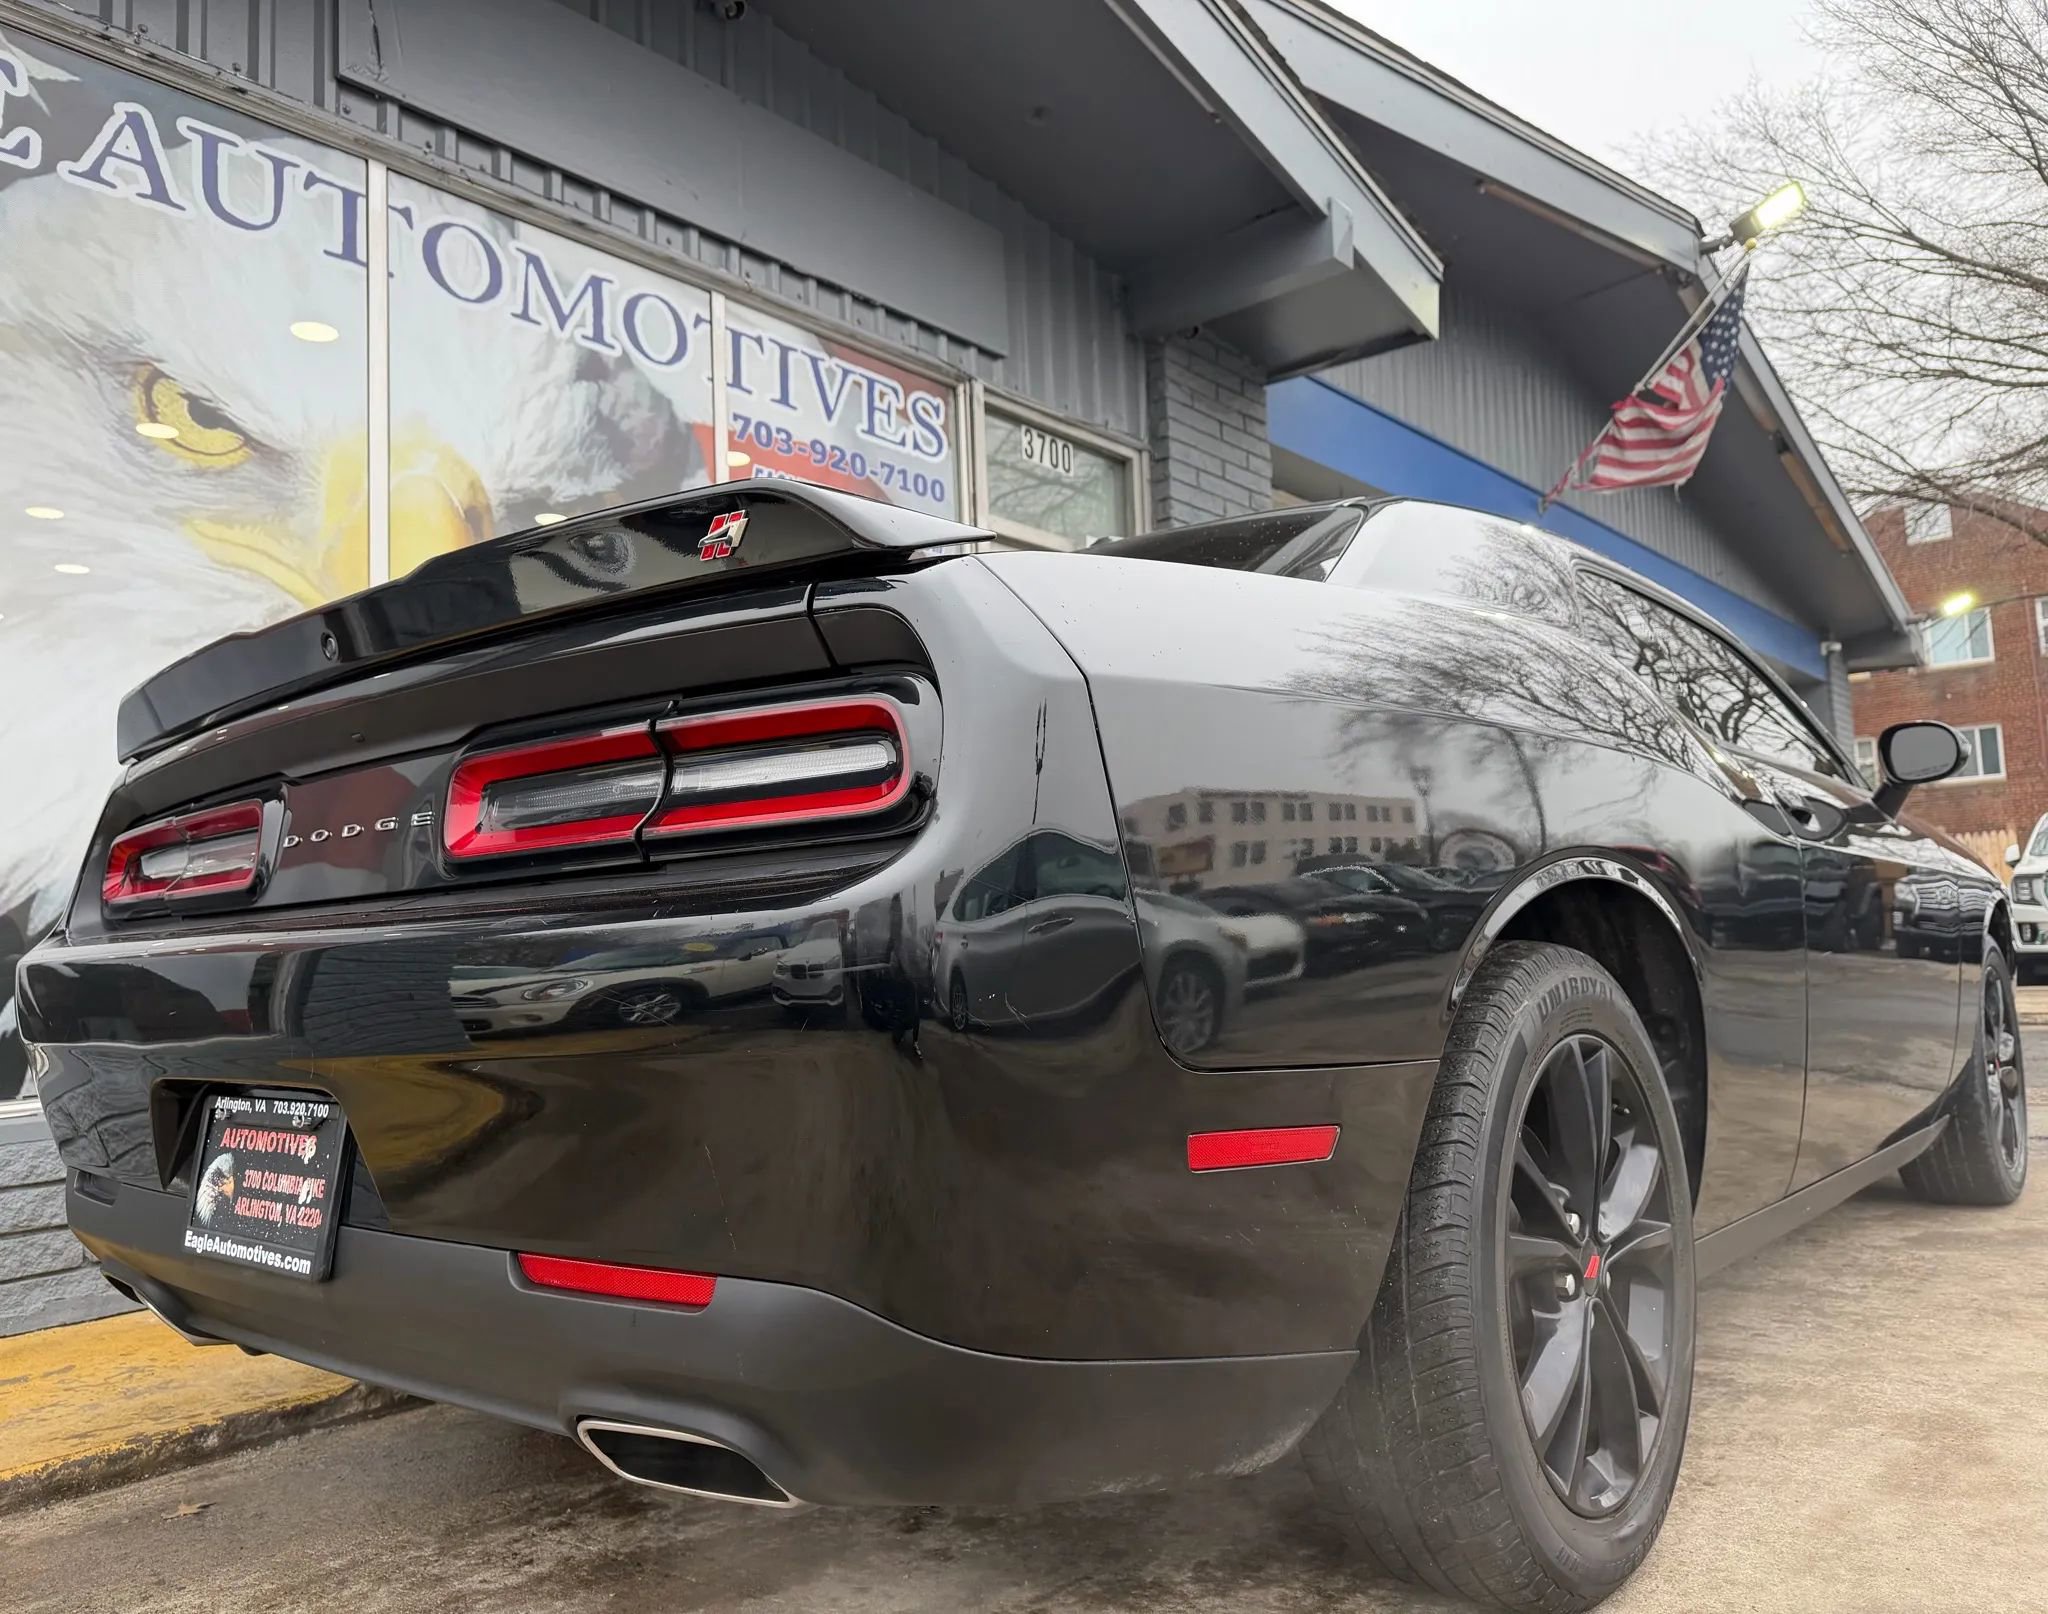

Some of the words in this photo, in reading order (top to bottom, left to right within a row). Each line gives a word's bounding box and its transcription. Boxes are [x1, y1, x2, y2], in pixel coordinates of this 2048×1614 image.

[64, 106, 946, 457] AUTOMOTIVES
[732, 412, 946, 502] 703-920-7100
[1024, 427, 1071, 474] 3700
[282, 811, 435, 848] DODGE
[214, 1096, 253, 1114] Arlington,
[255, 1099, 267, 1113] VA
[272, 1100, 330, 1119] 703.920.7100
[220, 1127, 318, 1158] AUTOMOTIVES
[242, 1169, 263, 1190] 3700
[261, 1171, 304, 1196] COLUMBIA
[233, 1196, 283, 1227] ARLINGTON,
[285, 1204, 297, 1225] VA
[184, 1230, 312, 1275] EagleAutomotives.com
